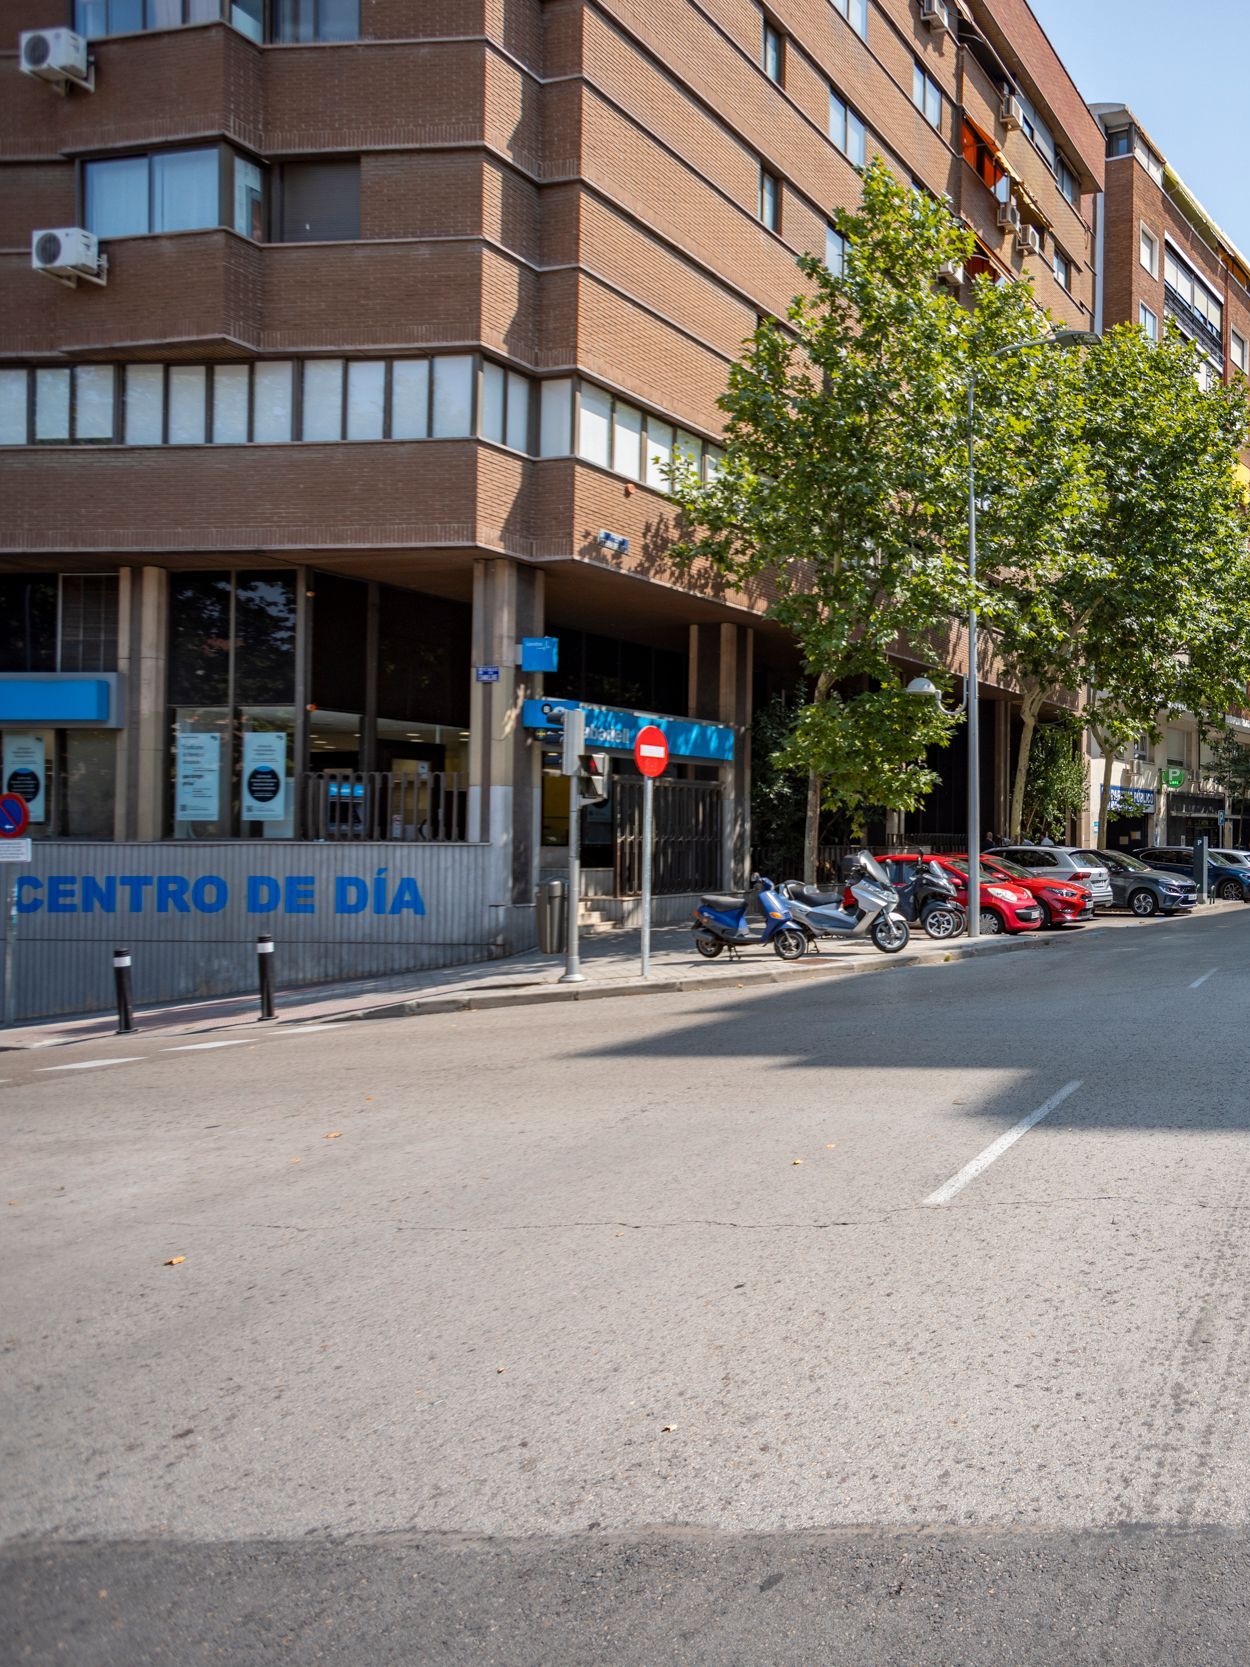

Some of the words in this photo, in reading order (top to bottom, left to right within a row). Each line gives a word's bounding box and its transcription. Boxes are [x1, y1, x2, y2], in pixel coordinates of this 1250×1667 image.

[584, 725, 630, 744] abadell
[1168, 768, 1181, 781] P
[16, 874, 228, 915] CENTRO
[247, 874, 315, 915] DE
[335, 867, 426, 917] DÍA
